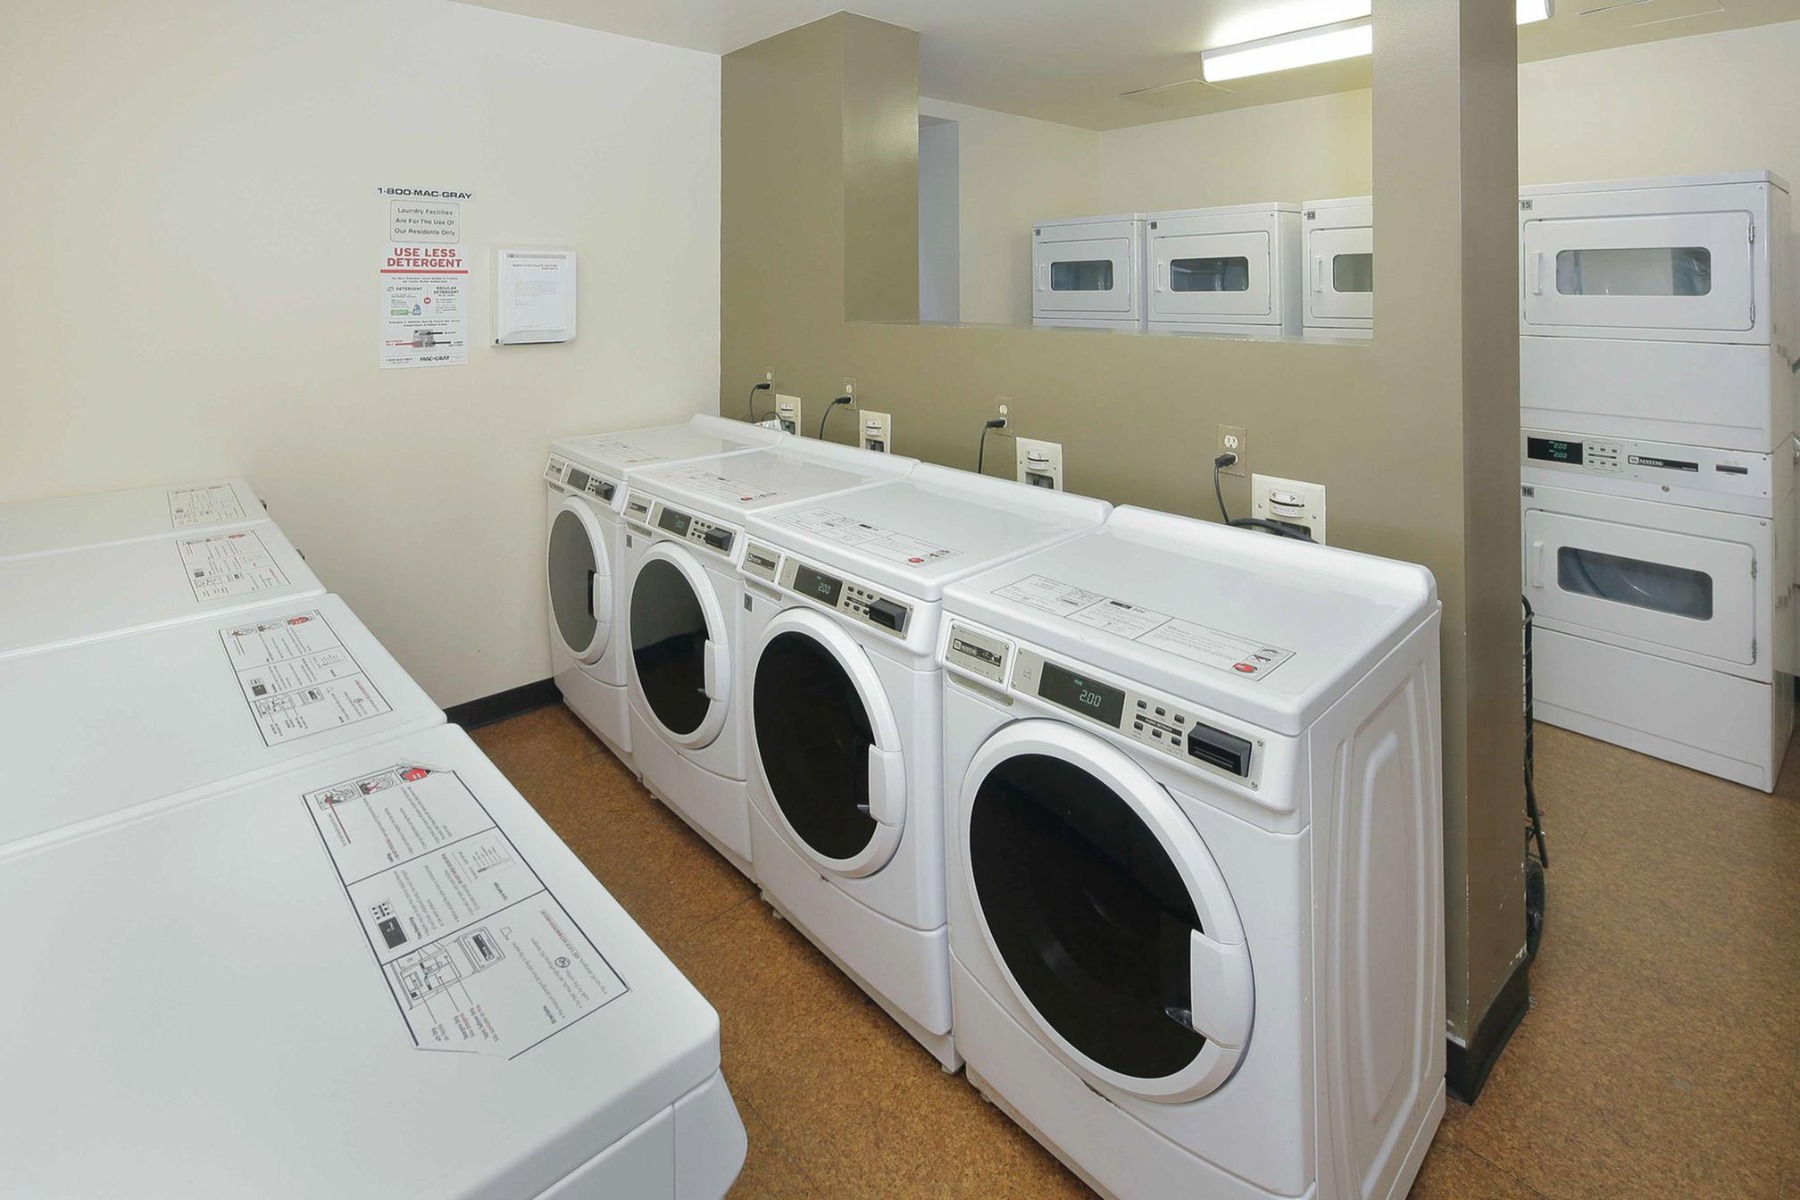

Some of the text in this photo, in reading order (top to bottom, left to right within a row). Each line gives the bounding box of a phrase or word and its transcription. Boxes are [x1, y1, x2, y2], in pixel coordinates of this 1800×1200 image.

[377, 187, 472, 199] 1-800-MAC-GRAY
[397, 207, 424, 215] Laundry
[394, 247, 456, 258] USE LESS
[387, 257, 462, 268] DETERGENT
[1079, 689, 1102, 707] 2.00
